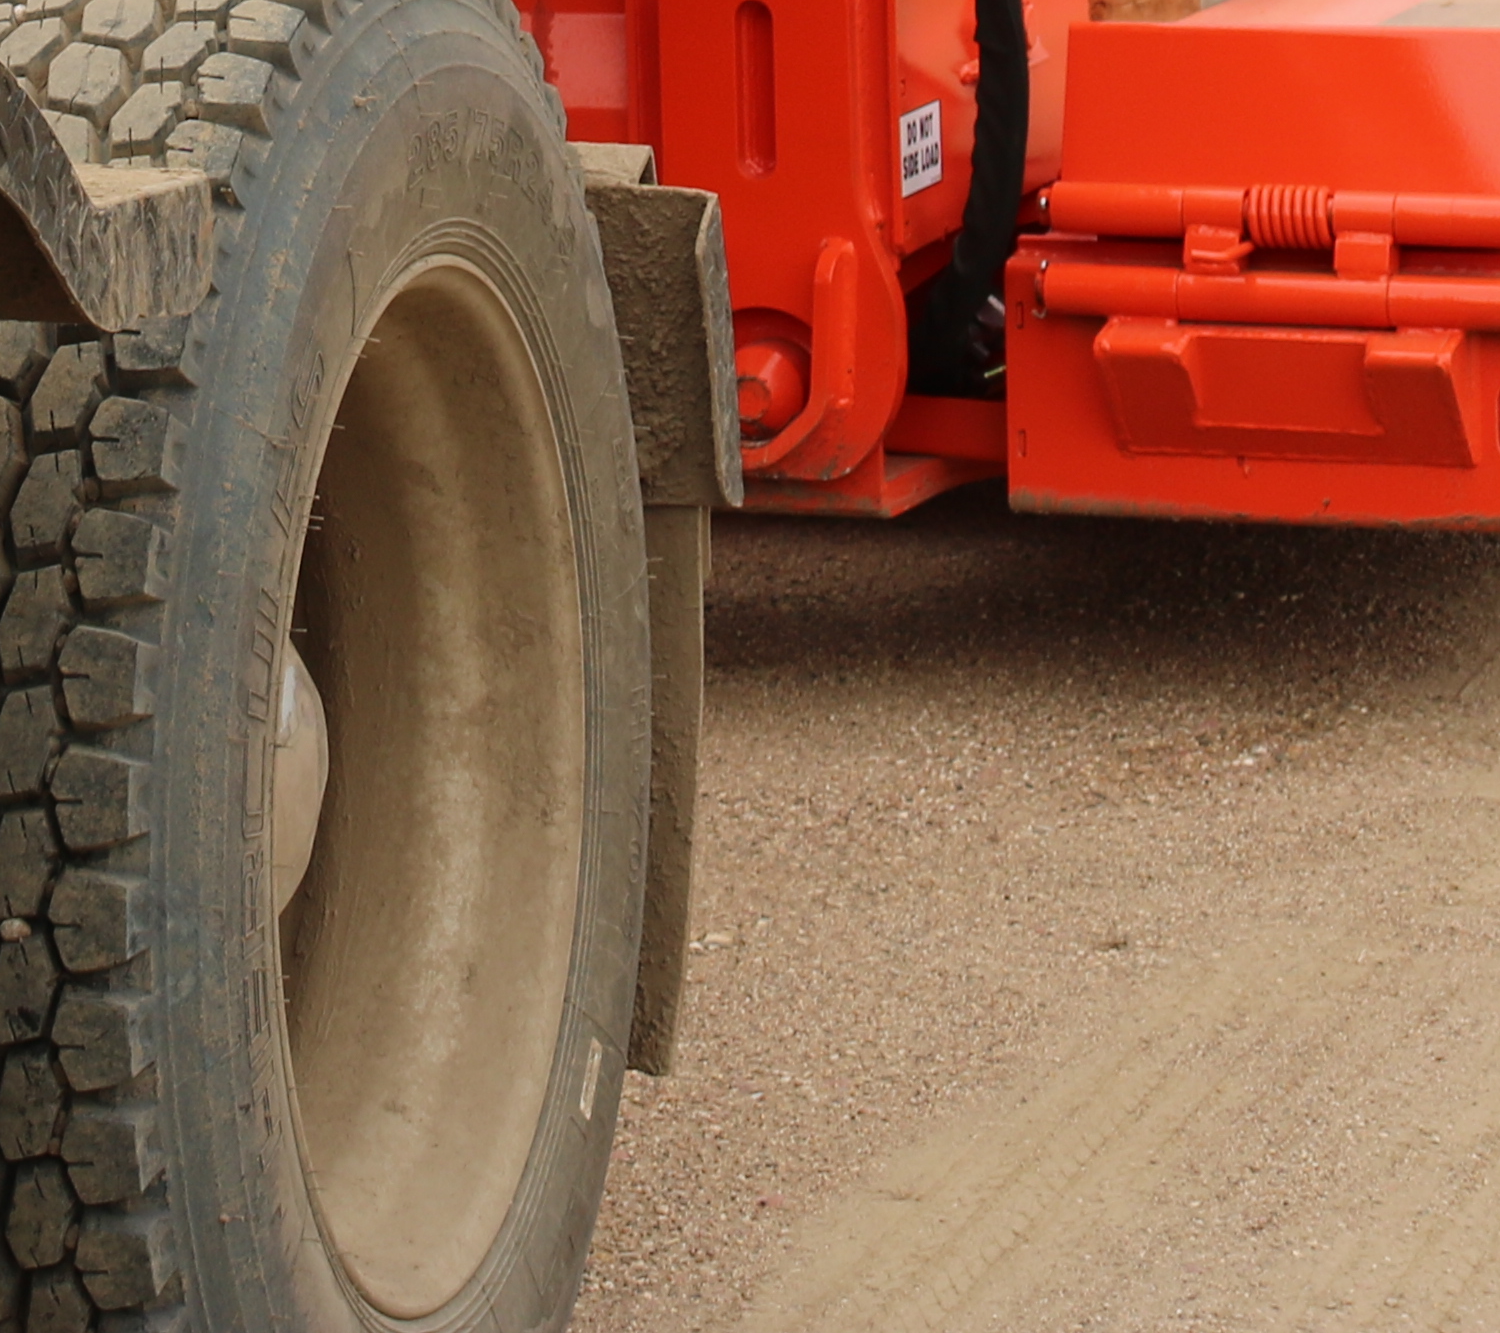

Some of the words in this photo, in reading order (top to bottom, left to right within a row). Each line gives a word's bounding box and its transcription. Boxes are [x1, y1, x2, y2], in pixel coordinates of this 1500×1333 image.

[906, 120, 917, 146] DO
[919, 113, 933, 141] NOT
[903, 151, 919, 180] SIDE
[921, 142, 939, 172] LOAD
